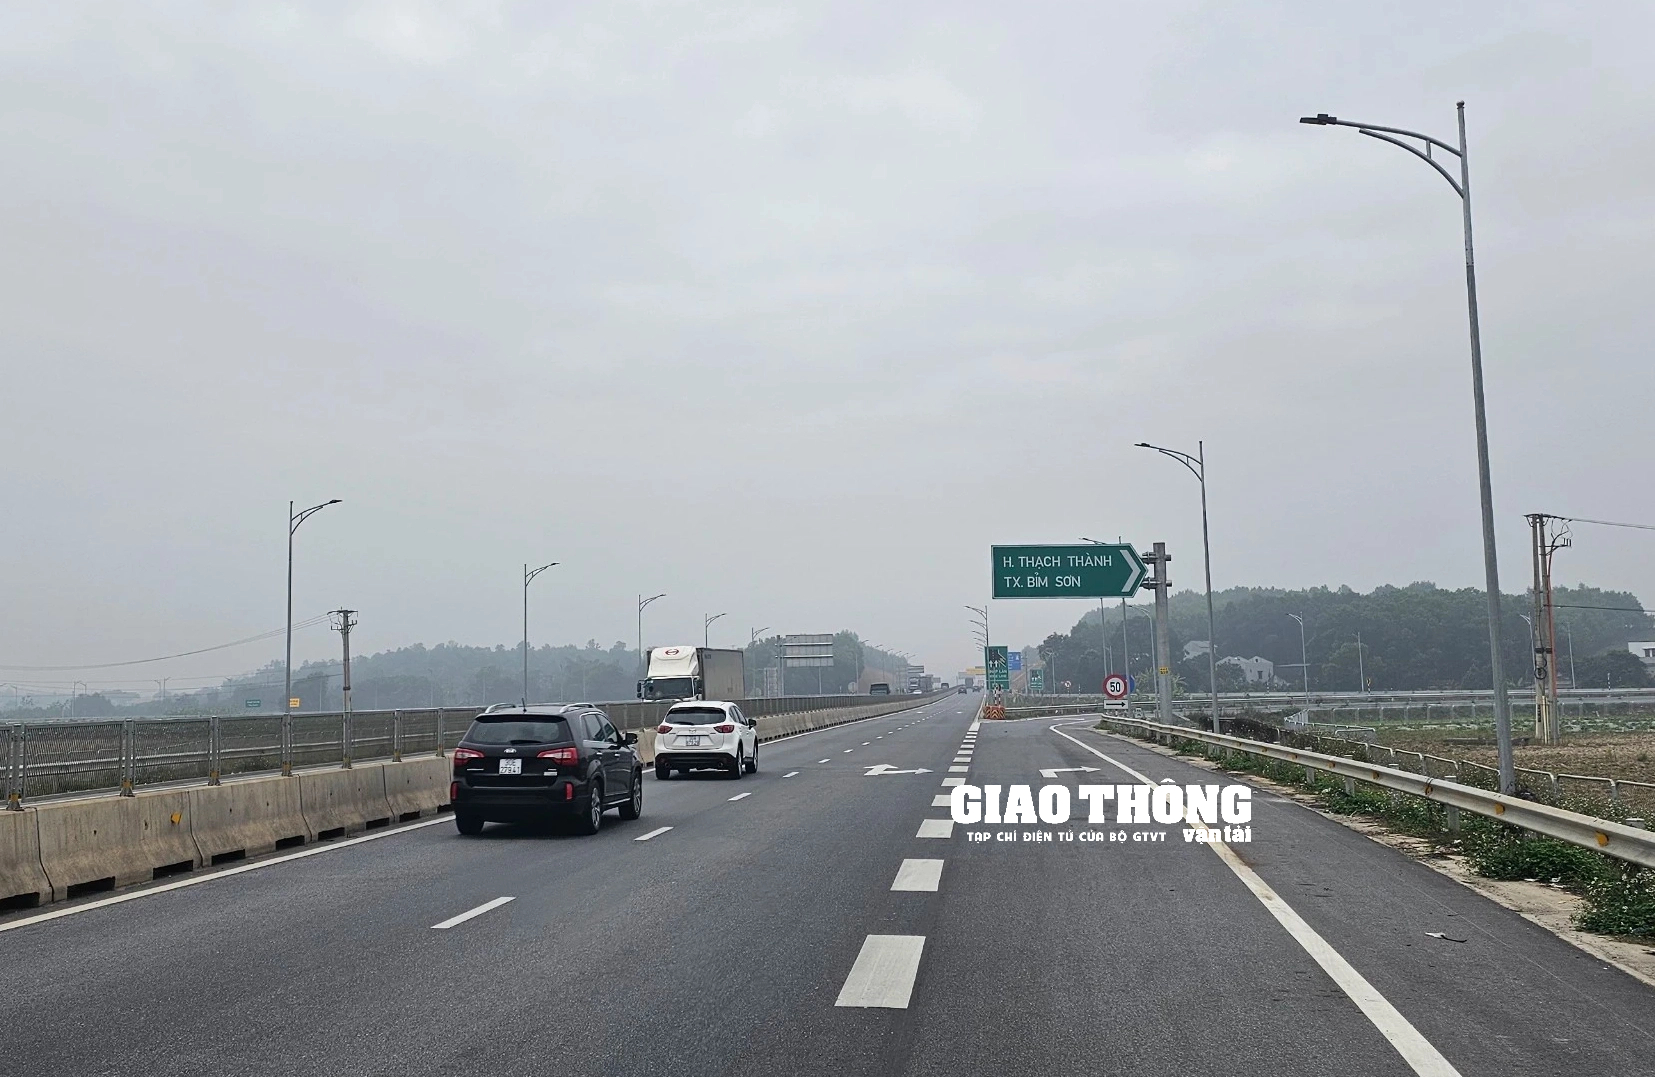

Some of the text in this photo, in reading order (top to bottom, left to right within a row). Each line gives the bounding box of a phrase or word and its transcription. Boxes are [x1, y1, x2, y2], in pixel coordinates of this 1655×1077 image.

[1003, 552, 1112, 570] H. THẠCH THÀNH
[1004, 571, 1081, 588] TX. BỈM SƠN
[1110, 681, 1121, 693] 50
